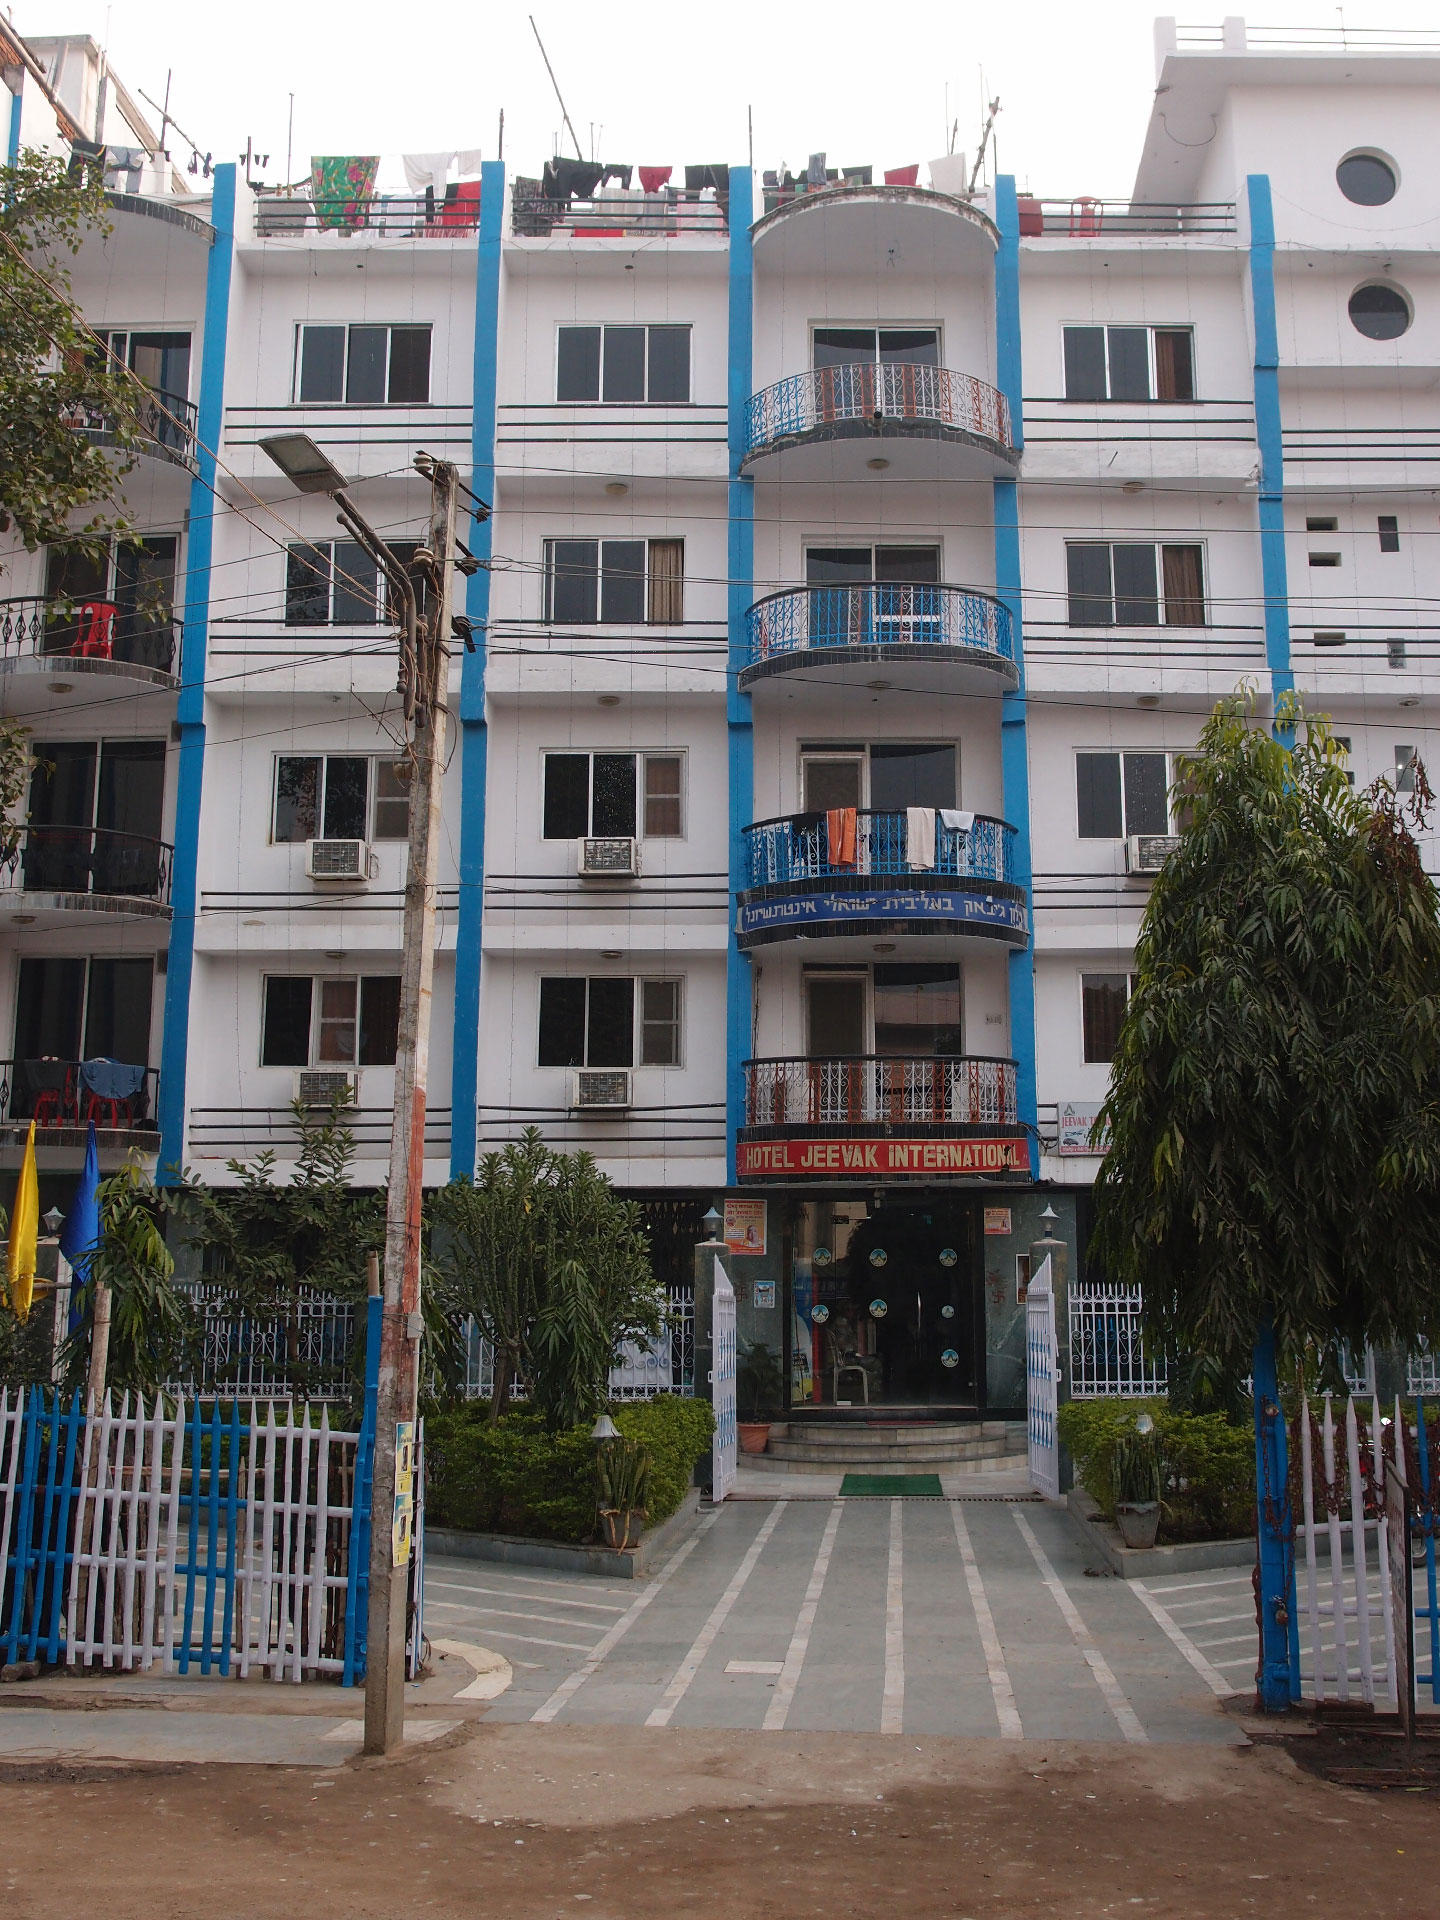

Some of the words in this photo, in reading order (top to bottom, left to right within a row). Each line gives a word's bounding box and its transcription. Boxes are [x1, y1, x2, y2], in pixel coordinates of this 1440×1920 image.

[1062, 1116, 1087, 1128] JEEVAK
[746, 1145, 795, 1169] HOTEL
[800, 1144, 879, 1168] JEEVAK
[888, 1144, 1021, 1168] INTERNATIONAL
